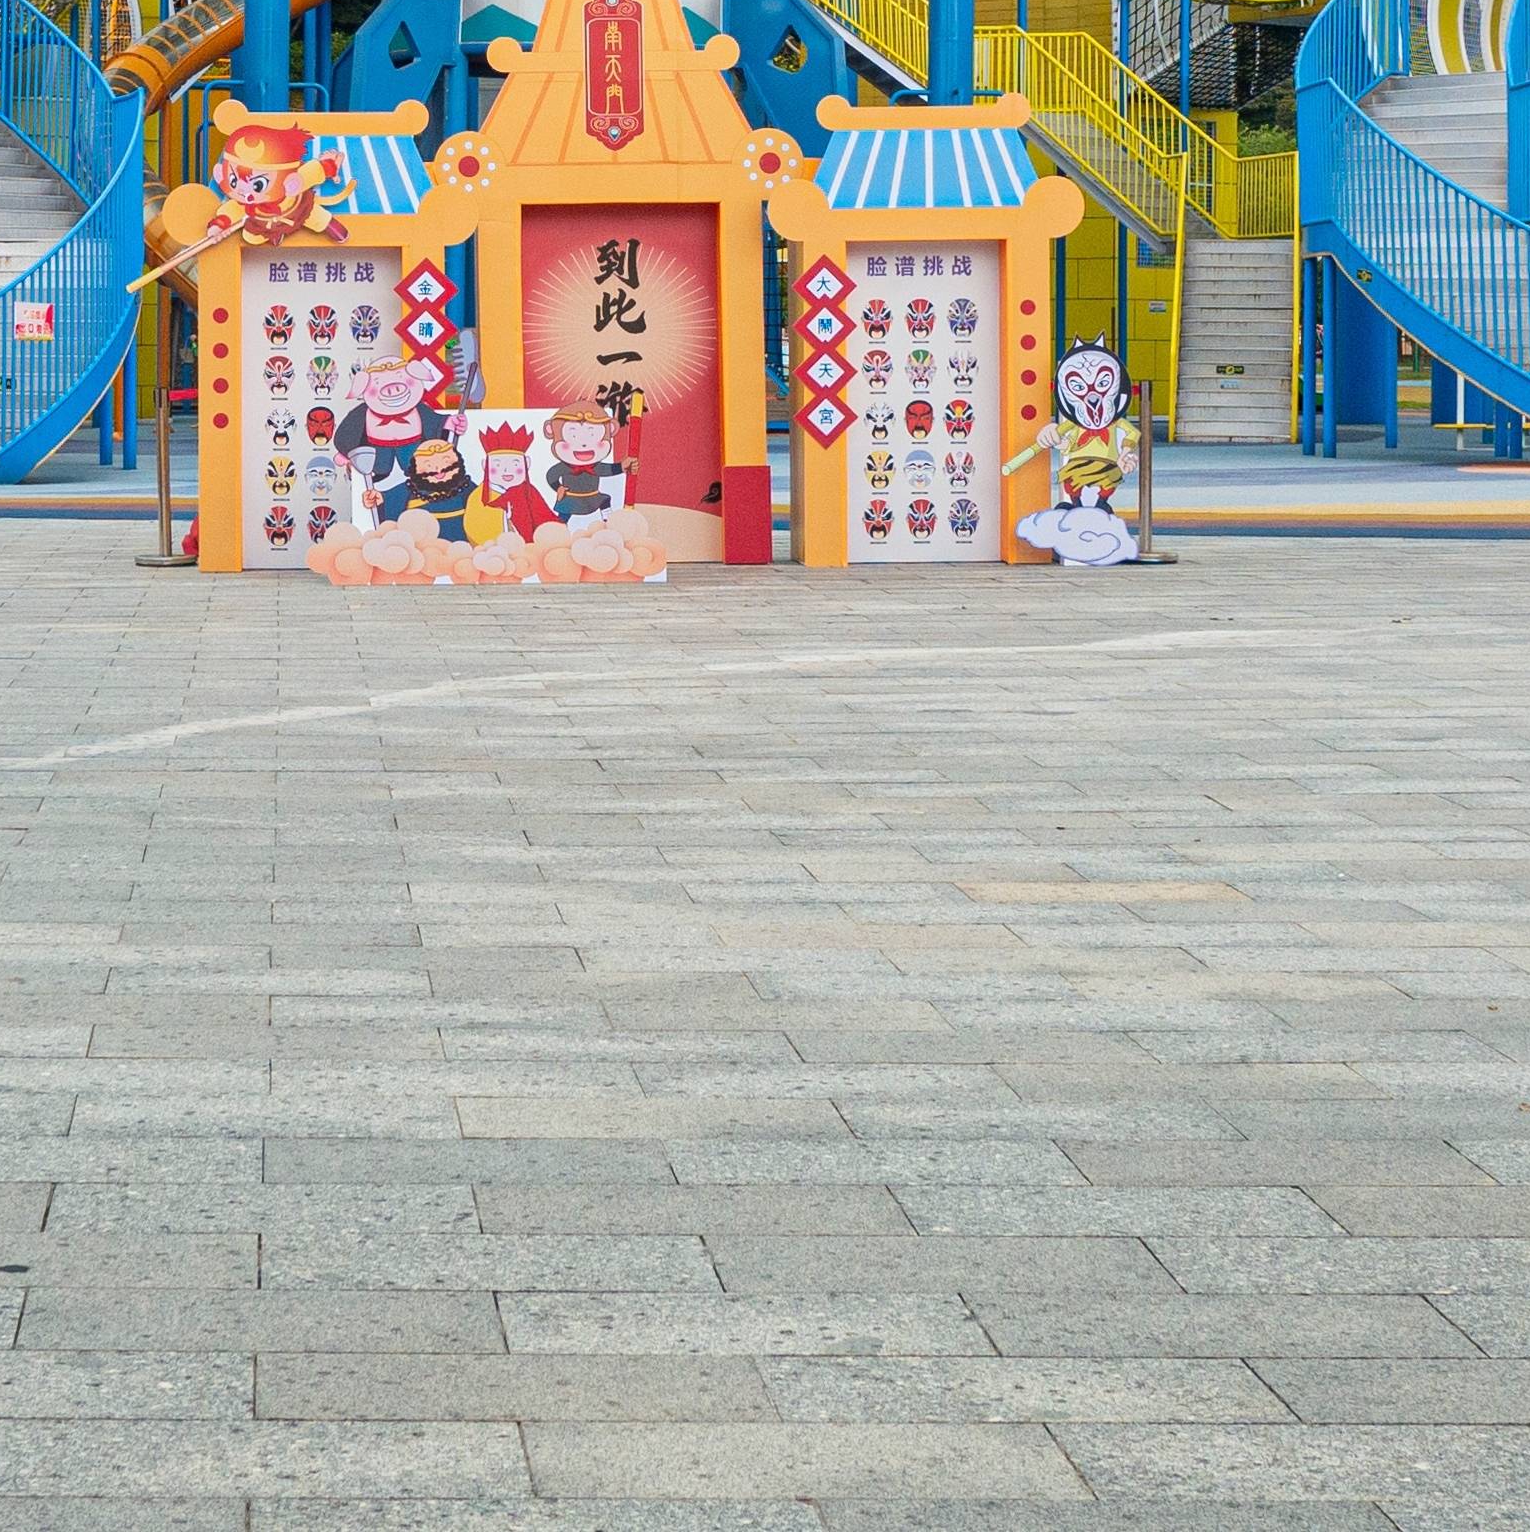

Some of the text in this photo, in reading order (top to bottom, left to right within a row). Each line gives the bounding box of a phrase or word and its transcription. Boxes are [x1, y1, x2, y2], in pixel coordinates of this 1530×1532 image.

[268, 261, 376, 284] 脸谱挑战
[865, 254, 973, 278] 脸谱挑战
